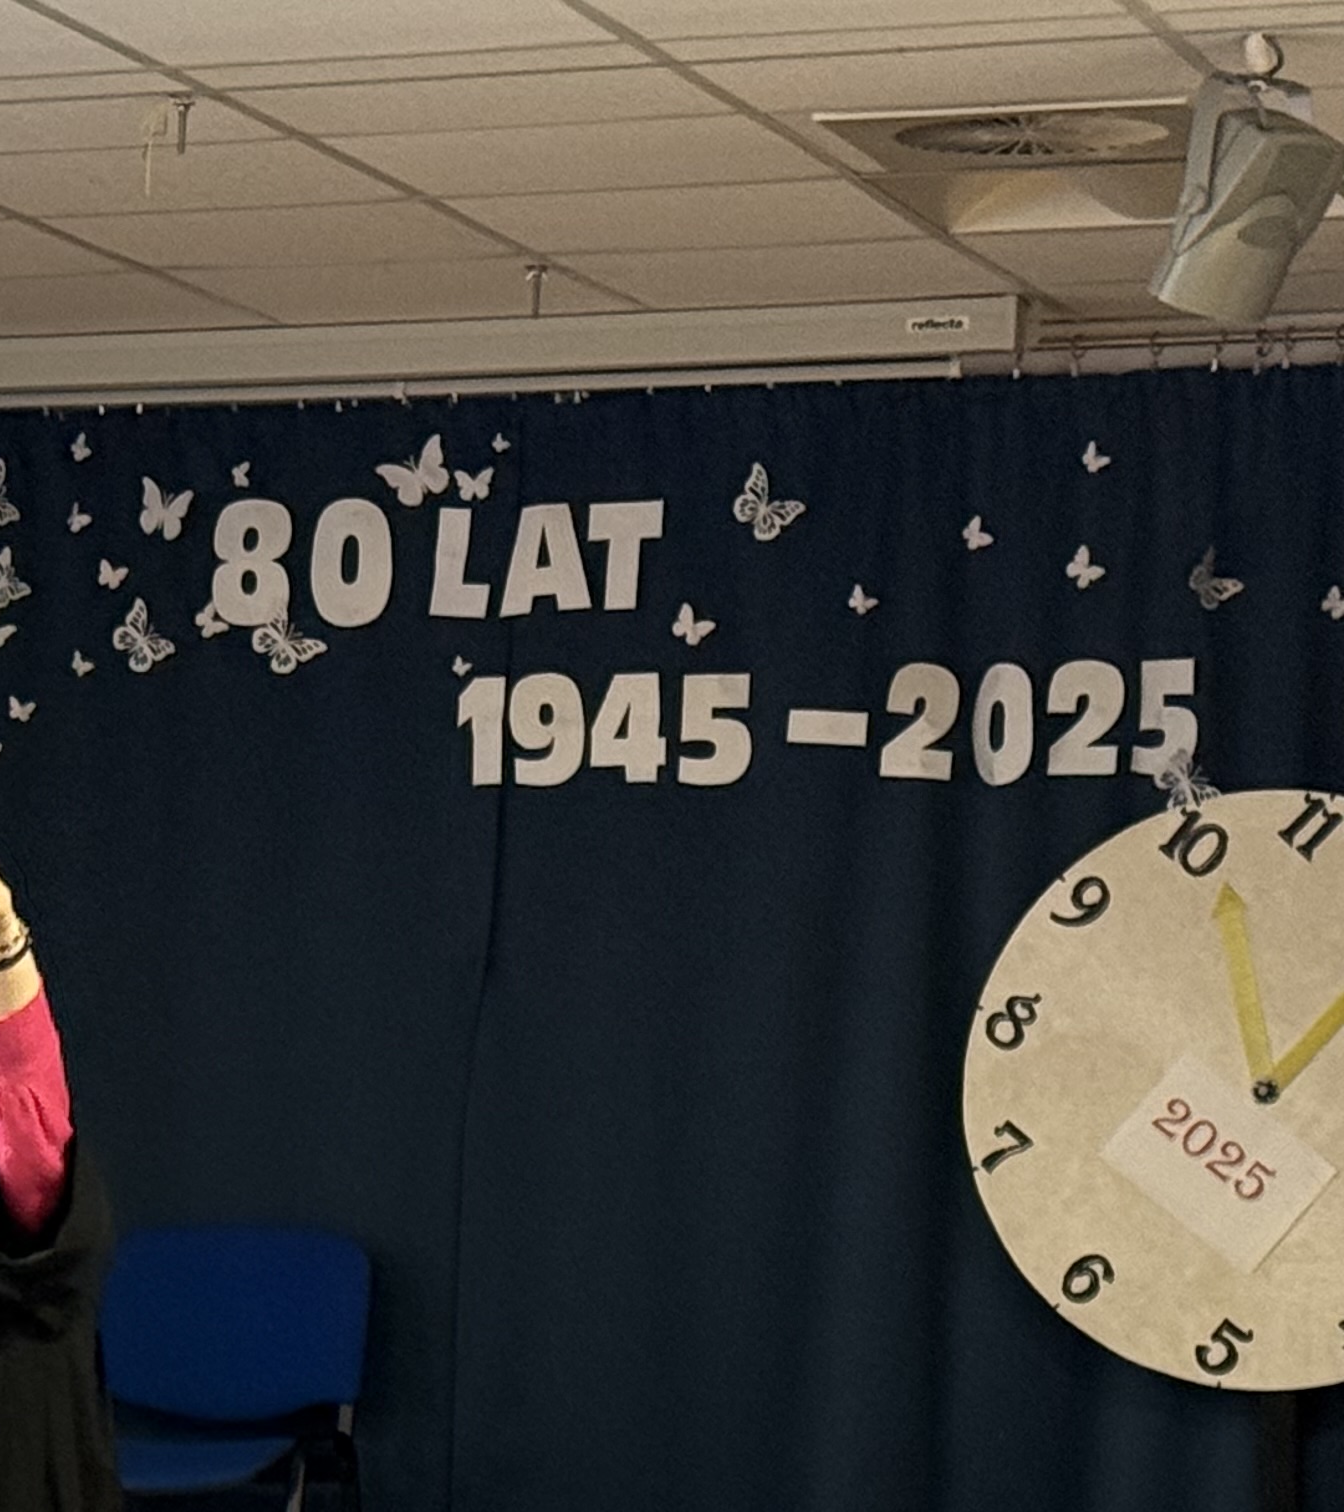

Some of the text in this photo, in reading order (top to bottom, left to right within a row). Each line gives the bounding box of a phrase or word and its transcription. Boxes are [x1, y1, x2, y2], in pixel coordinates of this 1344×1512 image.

[211, 496, 664, 628] 80 LAT
[456, 671, 753, 787] 1945
[878, 656, 1200, 788] 2025
[1159, 806, 1230, 878] 10
[1049, 875, 1111, 928] 9
[985, 993, 1041, 1051] 8
[981, 1119, 1035, 1175] 7
[1152, 1097, 1277, 1202] 2025
[1061, 1253, 1115, 1304] 6
[1195, 1317, 1254, 1376] 5
